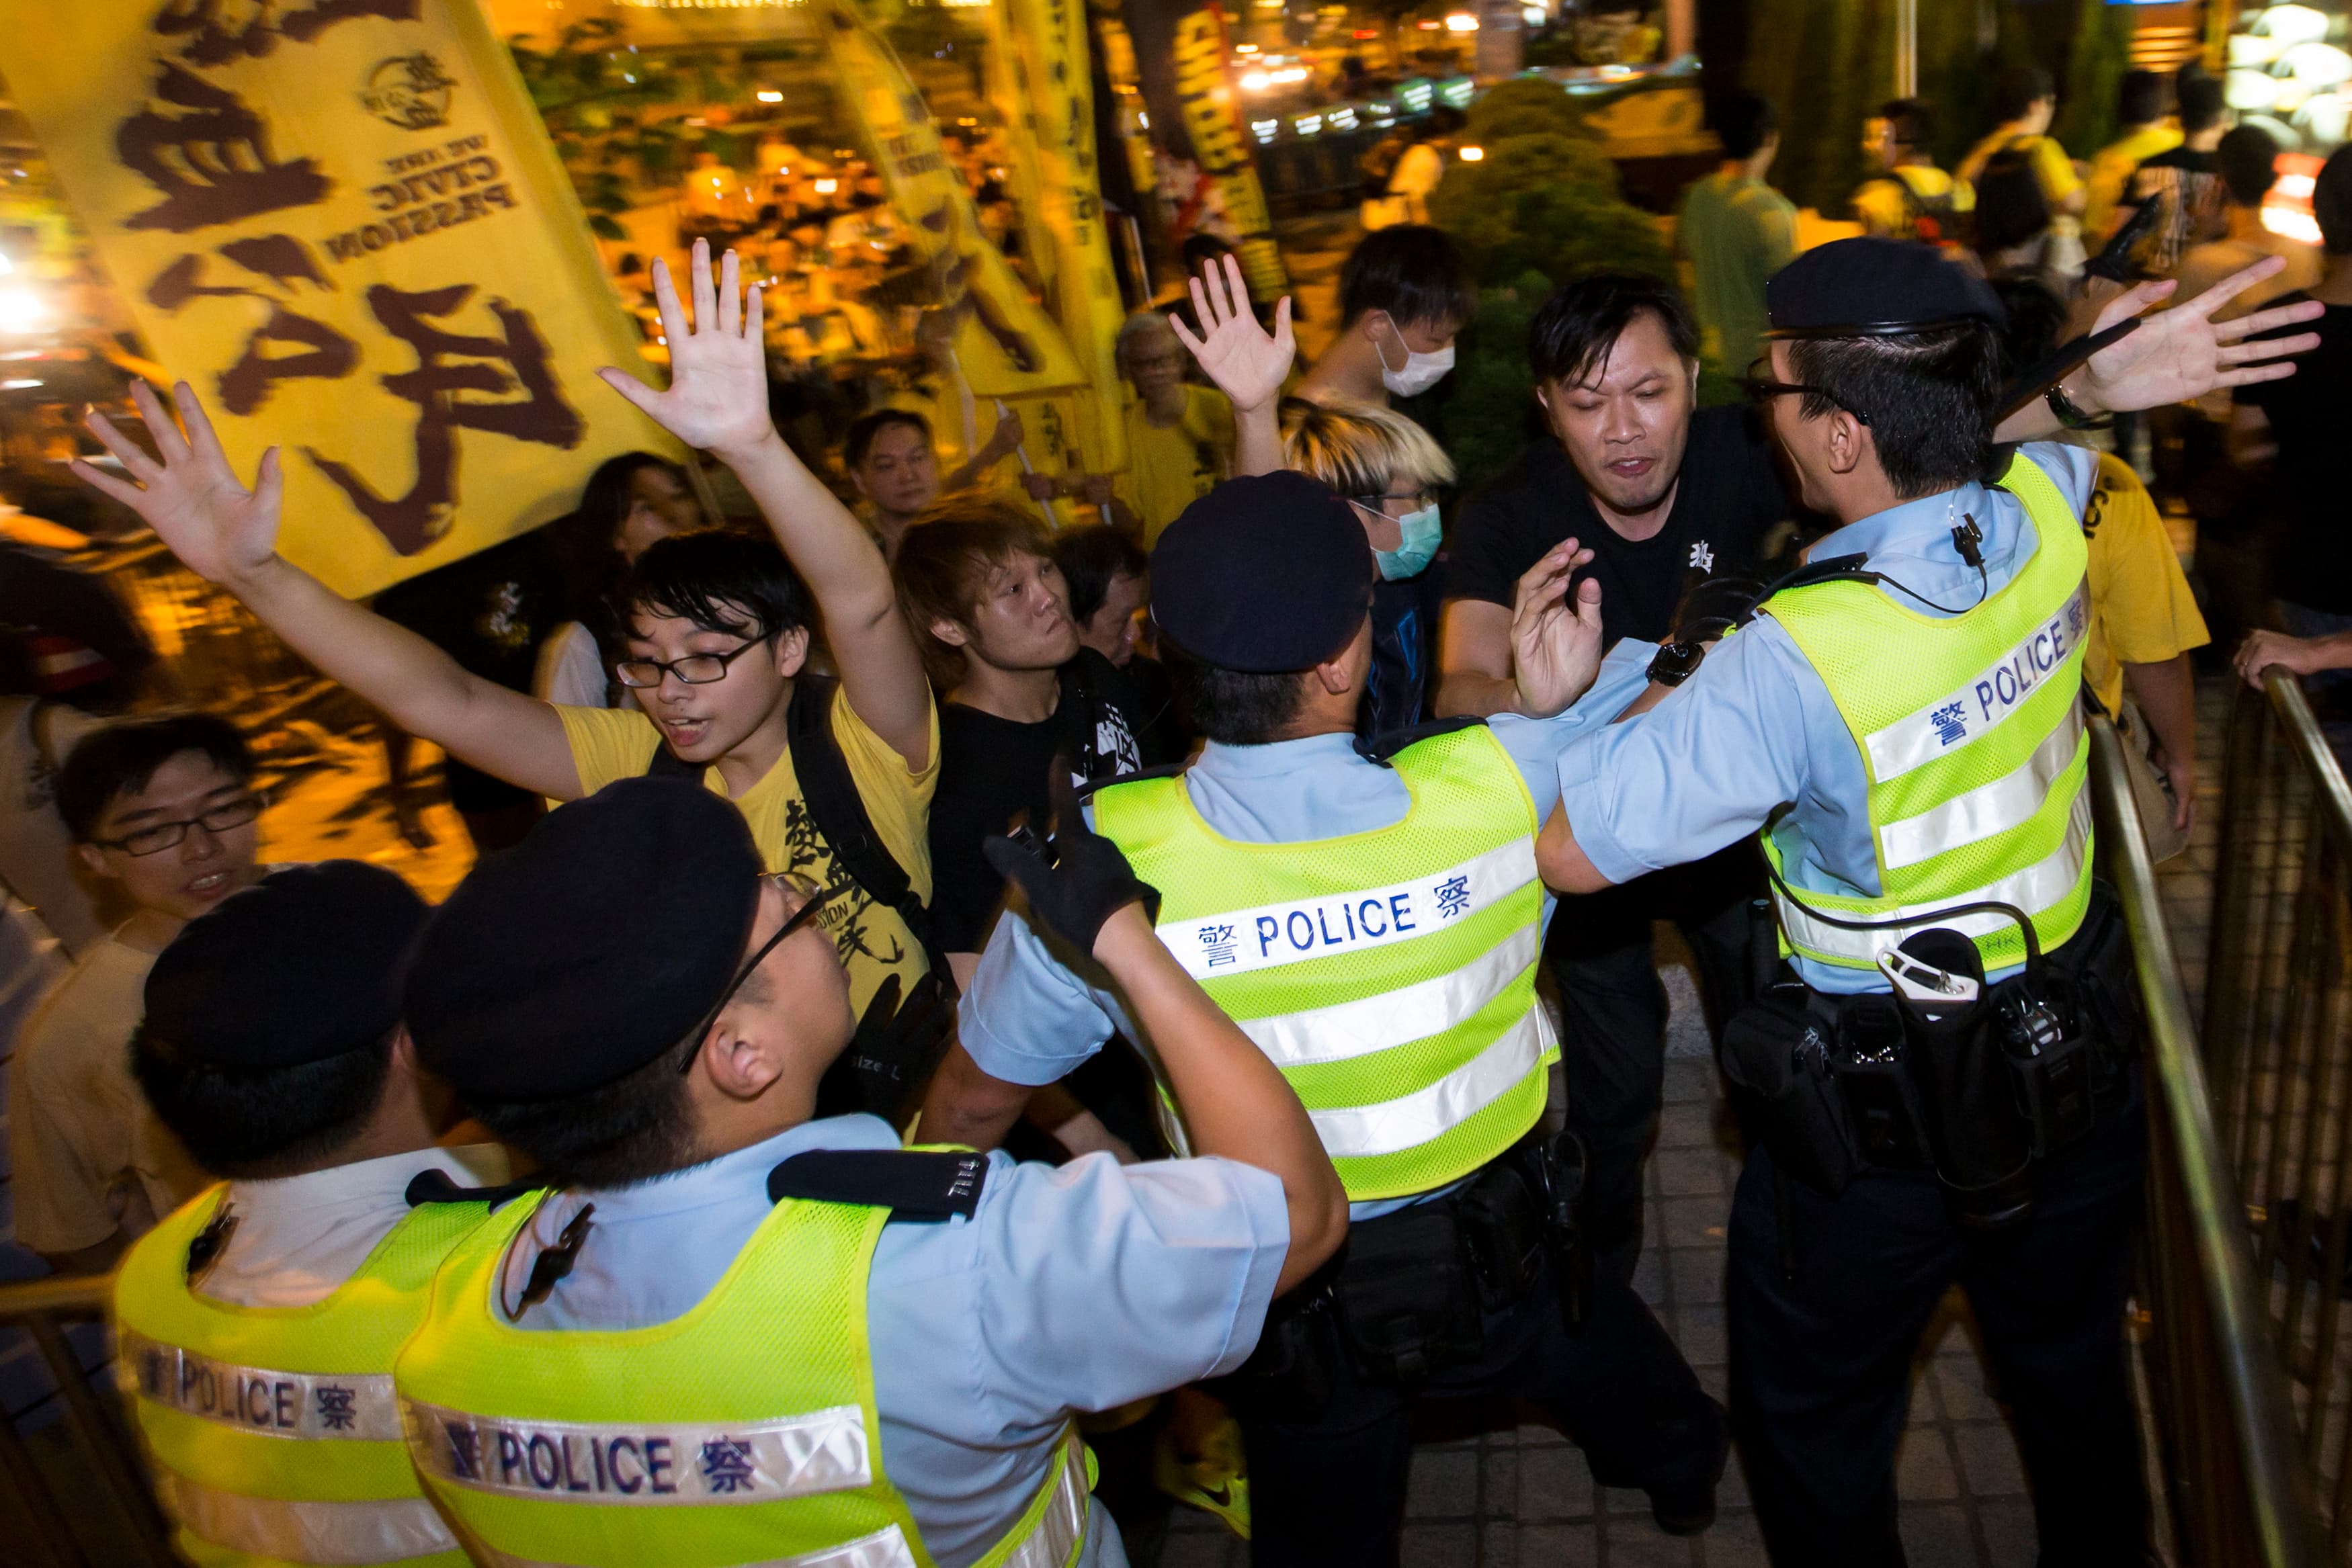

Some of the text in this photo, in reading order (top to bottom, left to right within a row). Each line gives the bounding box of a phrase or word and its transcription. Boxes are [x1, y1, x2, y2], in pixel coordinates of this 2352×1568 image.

[1930, 700, 1968, 746] 警
[1975, 620, 2066, 722] POLICE
[1198, 875, 1471, 967] 警 POLICE 察
[891, 1064, 900, 1081] L
[181, 1356, 296, 1428] POLICE
[317, 1383, 356, 1430] 察
[498, 1431, 677, 1494] POLICE
[702, 1435, 755, 1493] 察
